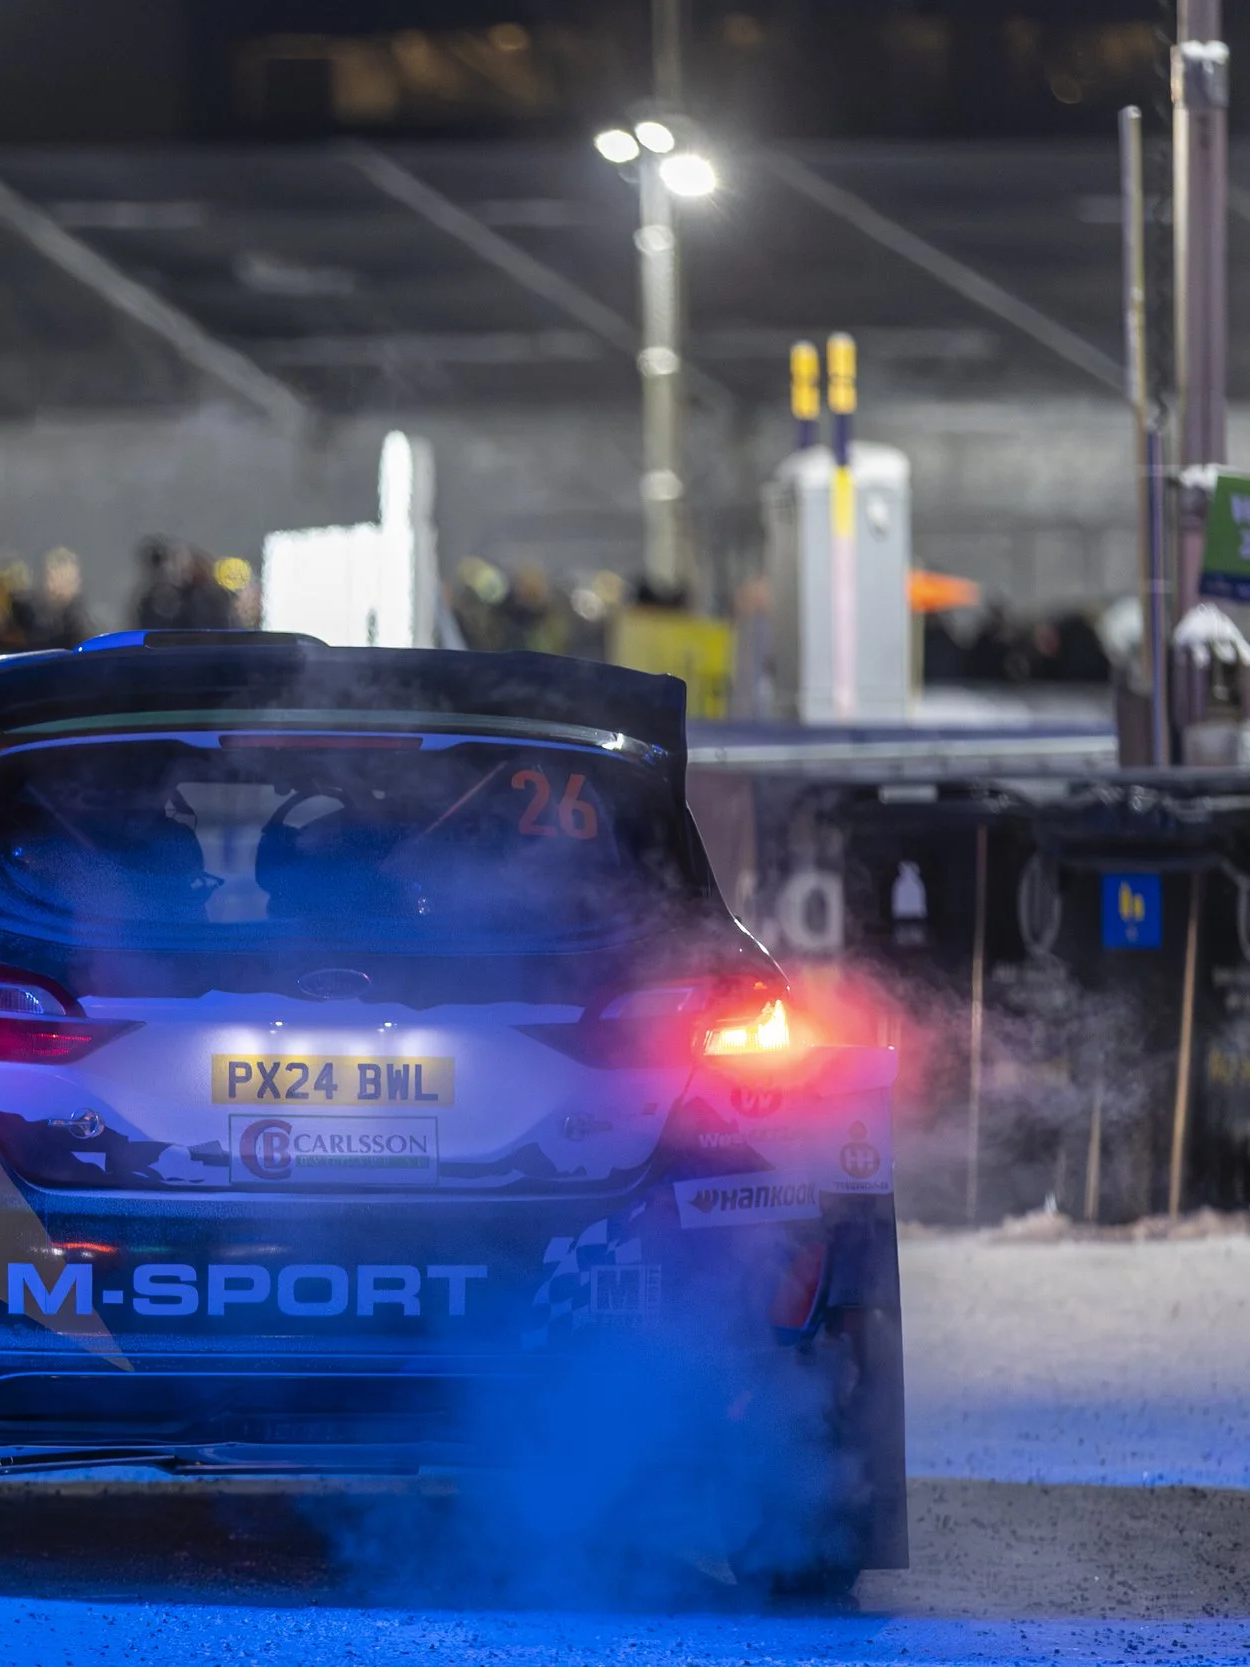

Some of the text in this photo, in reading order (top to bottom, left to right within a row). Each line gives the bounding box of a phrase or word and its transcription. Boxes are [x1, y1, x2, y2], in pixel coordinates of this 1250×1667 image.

[511, 769, 597, 840] 26
[228, 1061, 439, 1101] PX24 BWL
[294, 1134, 427, 1154] CARLSSON
[7, 1263, 486, 1317] M-SPORT
